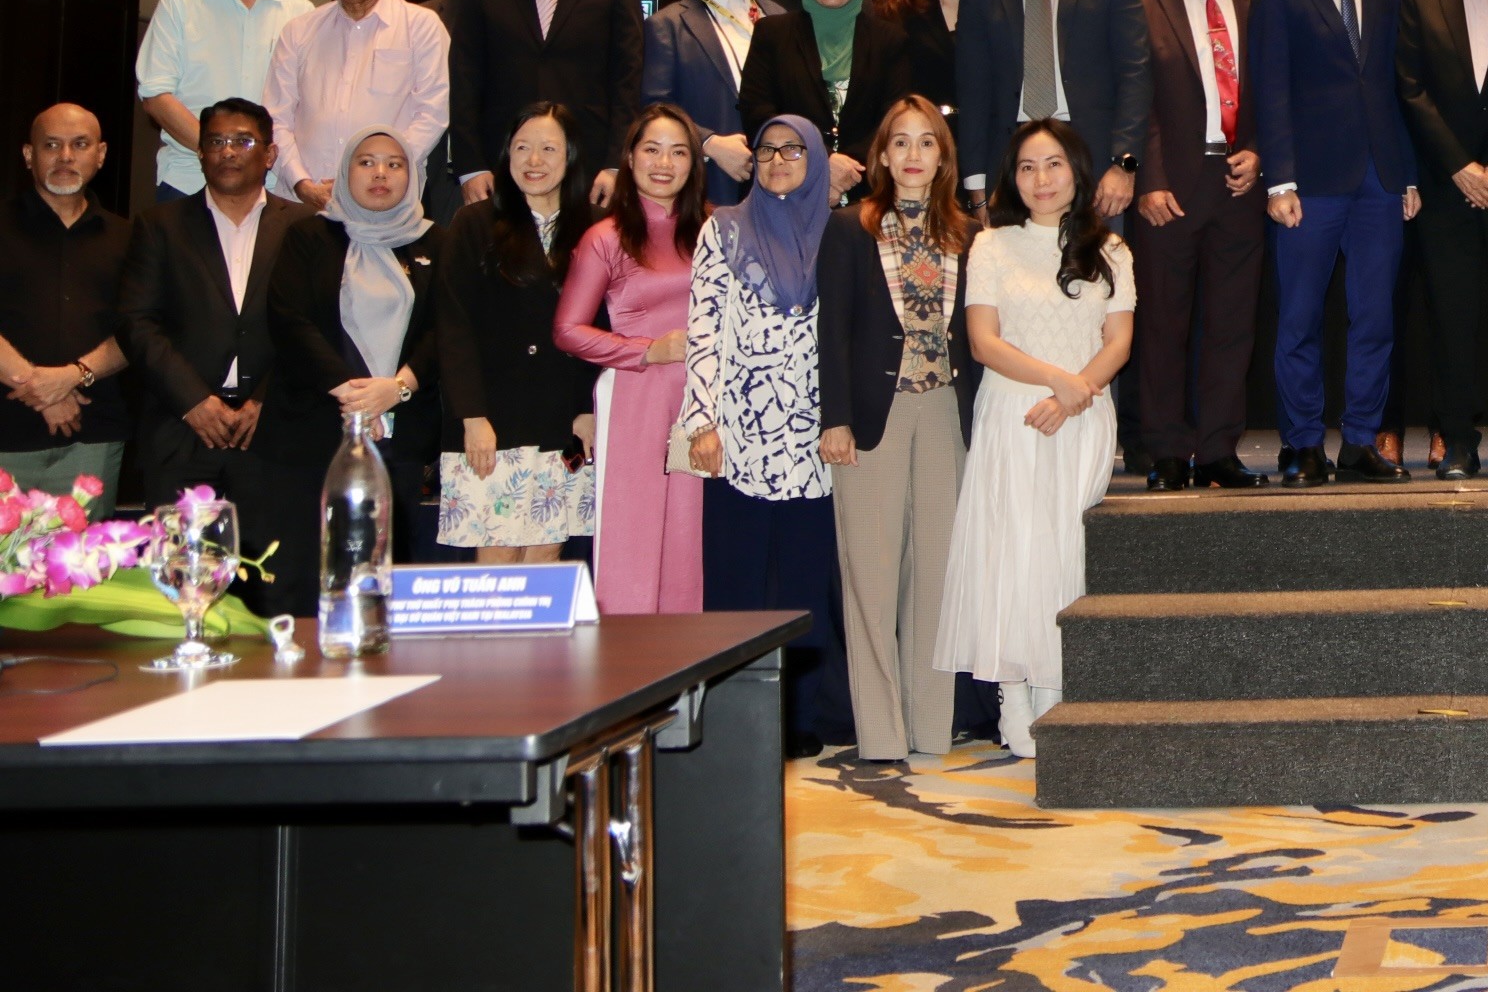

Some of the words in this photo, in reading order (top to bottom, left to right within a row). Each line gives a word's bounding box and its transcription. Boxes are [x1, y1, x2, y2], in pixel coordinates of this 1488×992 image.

[412, 576, 441, 594] ÔNG
[462, 573, 497, 592] TUẤN
[498, 576, 528, 592] ANH
